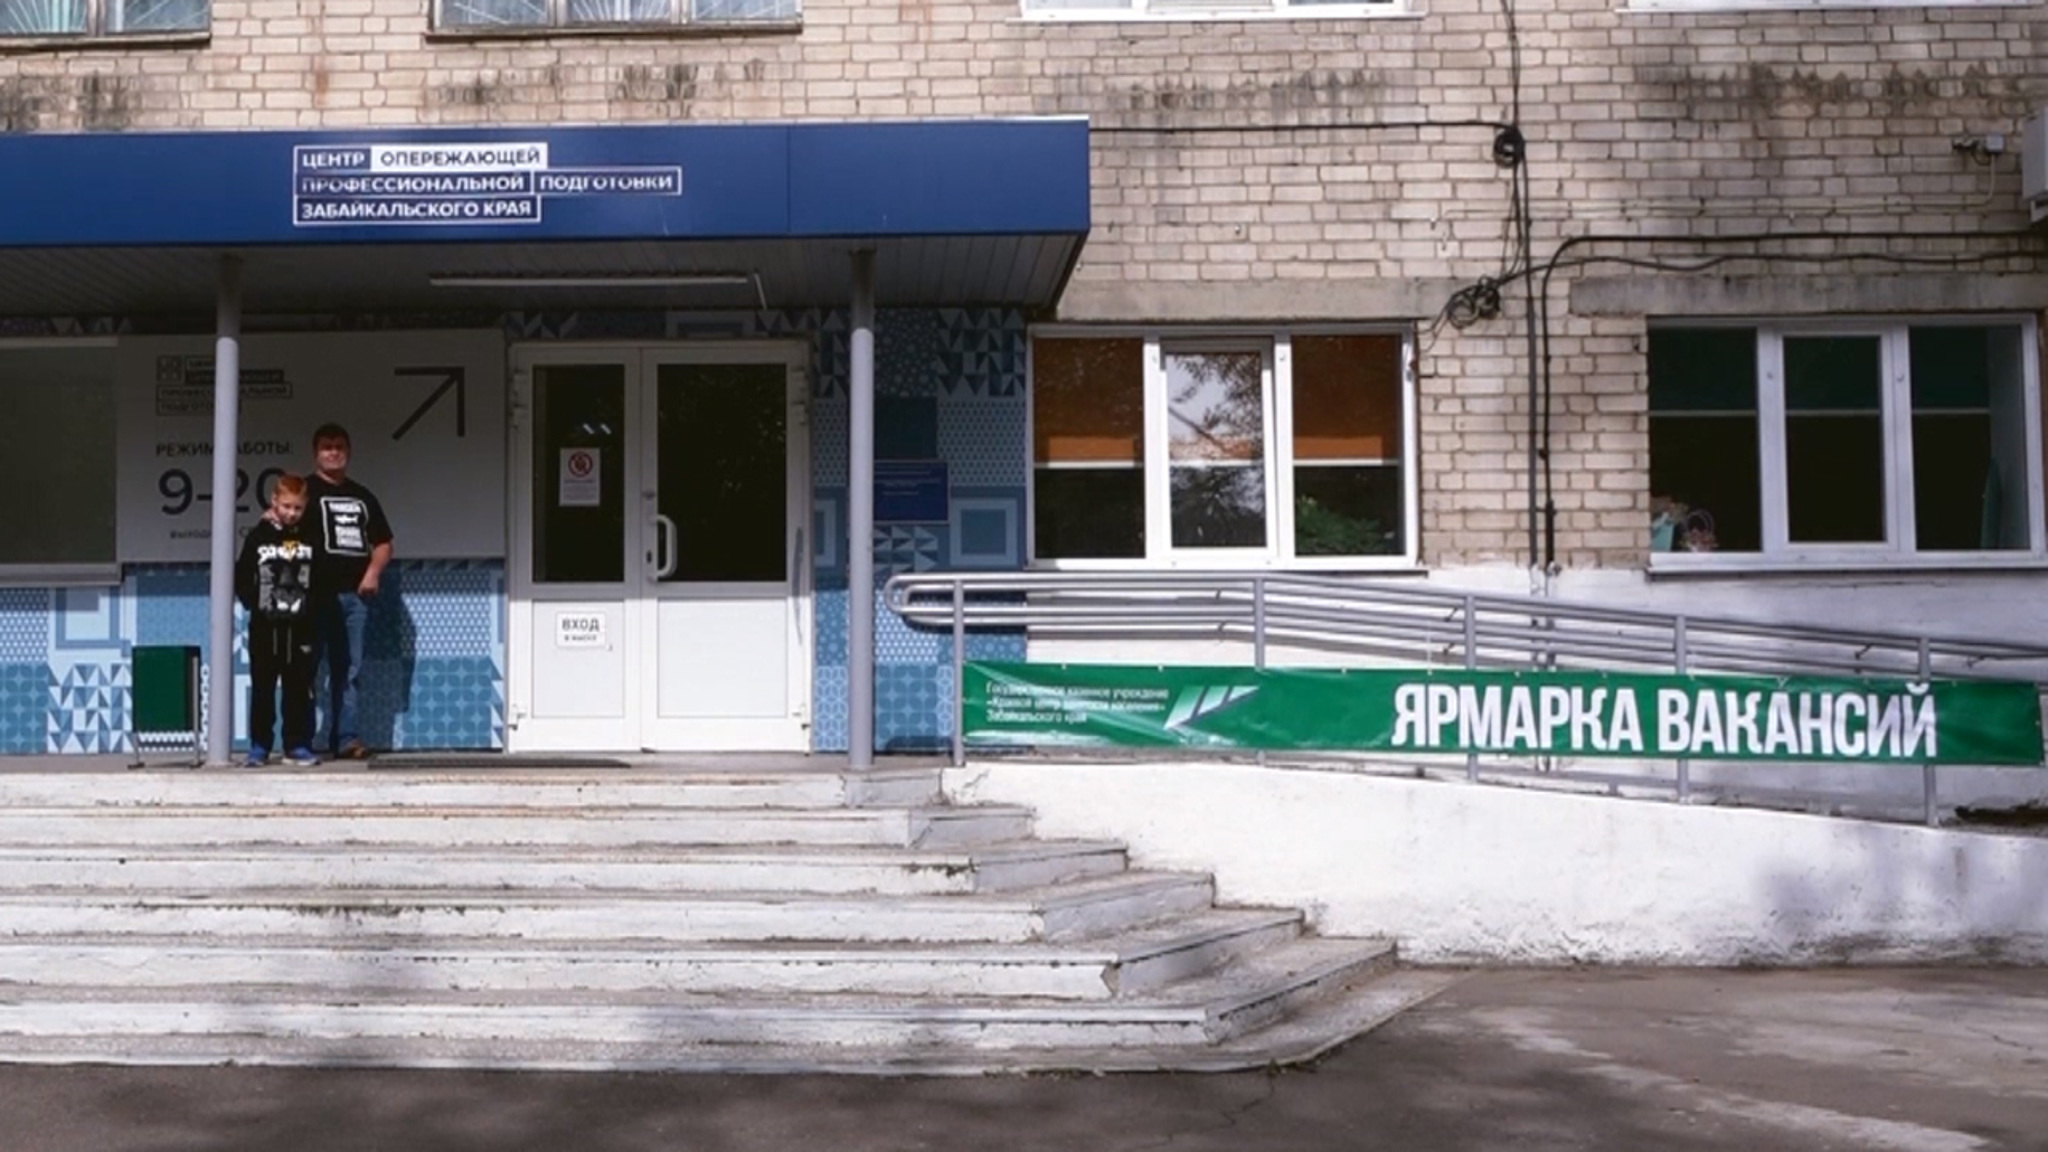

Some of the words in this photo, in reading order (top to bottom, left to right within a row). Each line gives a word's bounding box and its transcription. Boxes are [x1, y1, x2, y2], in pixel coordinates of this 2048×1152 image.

[302, 151, 366, 169] ЦЕНТР
[379, 148, 541, 168] ОПЕРЕЖАЮЩЕЙ
[301, 172, 525, 193] ПРОФЕССИОНАЛЬНОЙ
[540, 175, 673, 192] ПОДГОТОВКИ
[302, 199, 480, 219] ЗАБАЙКАЛЬСКОГО
[483, 200, 532, 217] КРАЯ
[562, 617, 600, 633] ВХОД
[1390, 683, 1644, 751] ЯРМАРКА
[1656, 682, 1938, 759] ВАКАНСИЙ
